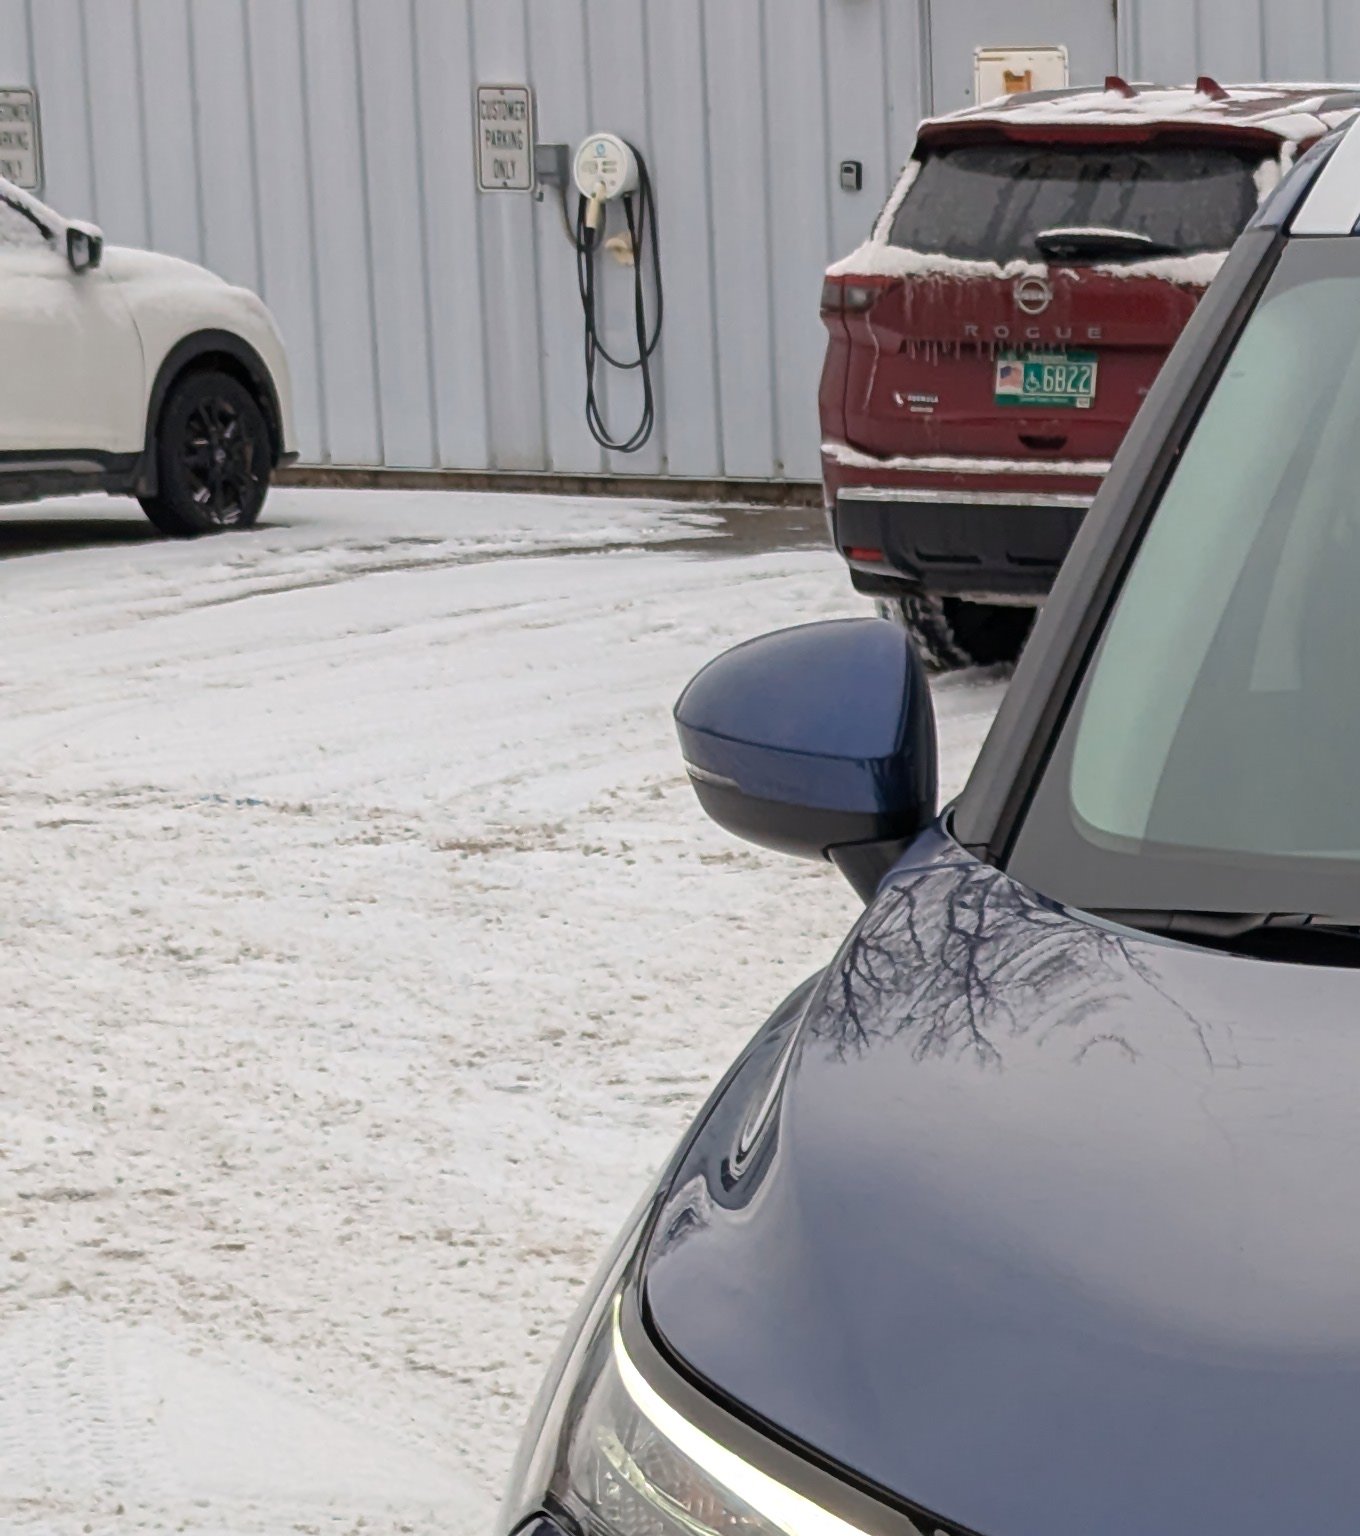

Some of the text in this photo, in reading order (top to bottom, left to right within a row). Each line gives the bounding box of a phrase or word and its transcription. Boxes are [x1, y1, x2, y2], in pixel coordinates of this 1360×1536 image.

[485, 128, 523, 151] PARKING
[493, 159, 517, 180] ONLY
[965, 324, 1102, 339] ROGUE
